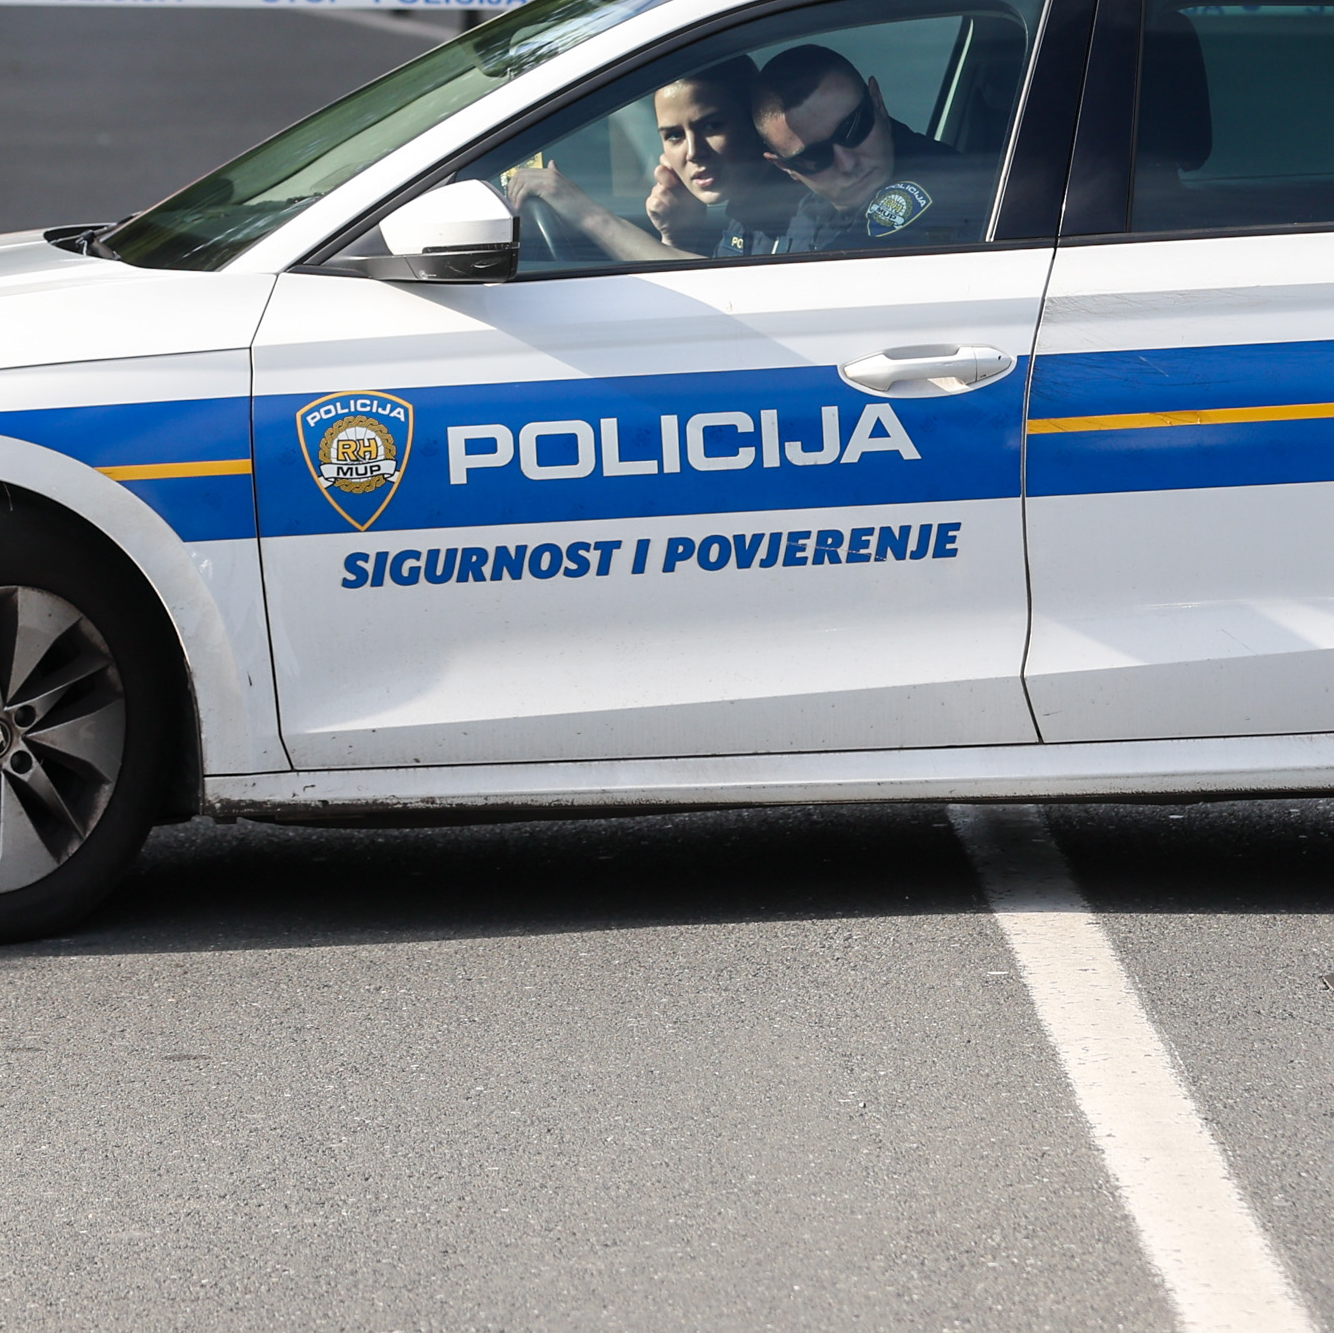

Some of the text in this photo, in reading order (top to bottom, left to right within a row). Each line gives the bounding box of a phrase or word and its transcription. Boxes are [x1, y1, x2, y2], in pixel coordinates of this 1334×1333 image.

[876, 207, 897, 220] MUP
[306, 399, 406, 427] POLICIJA
[337, 438, 378, 461] RH
[447, 403, 922, 486] POLICIJA
[336, 464, 382, 477] MUP
[341, 521, 962, 589] SIGURNOST I POVJERENJE
